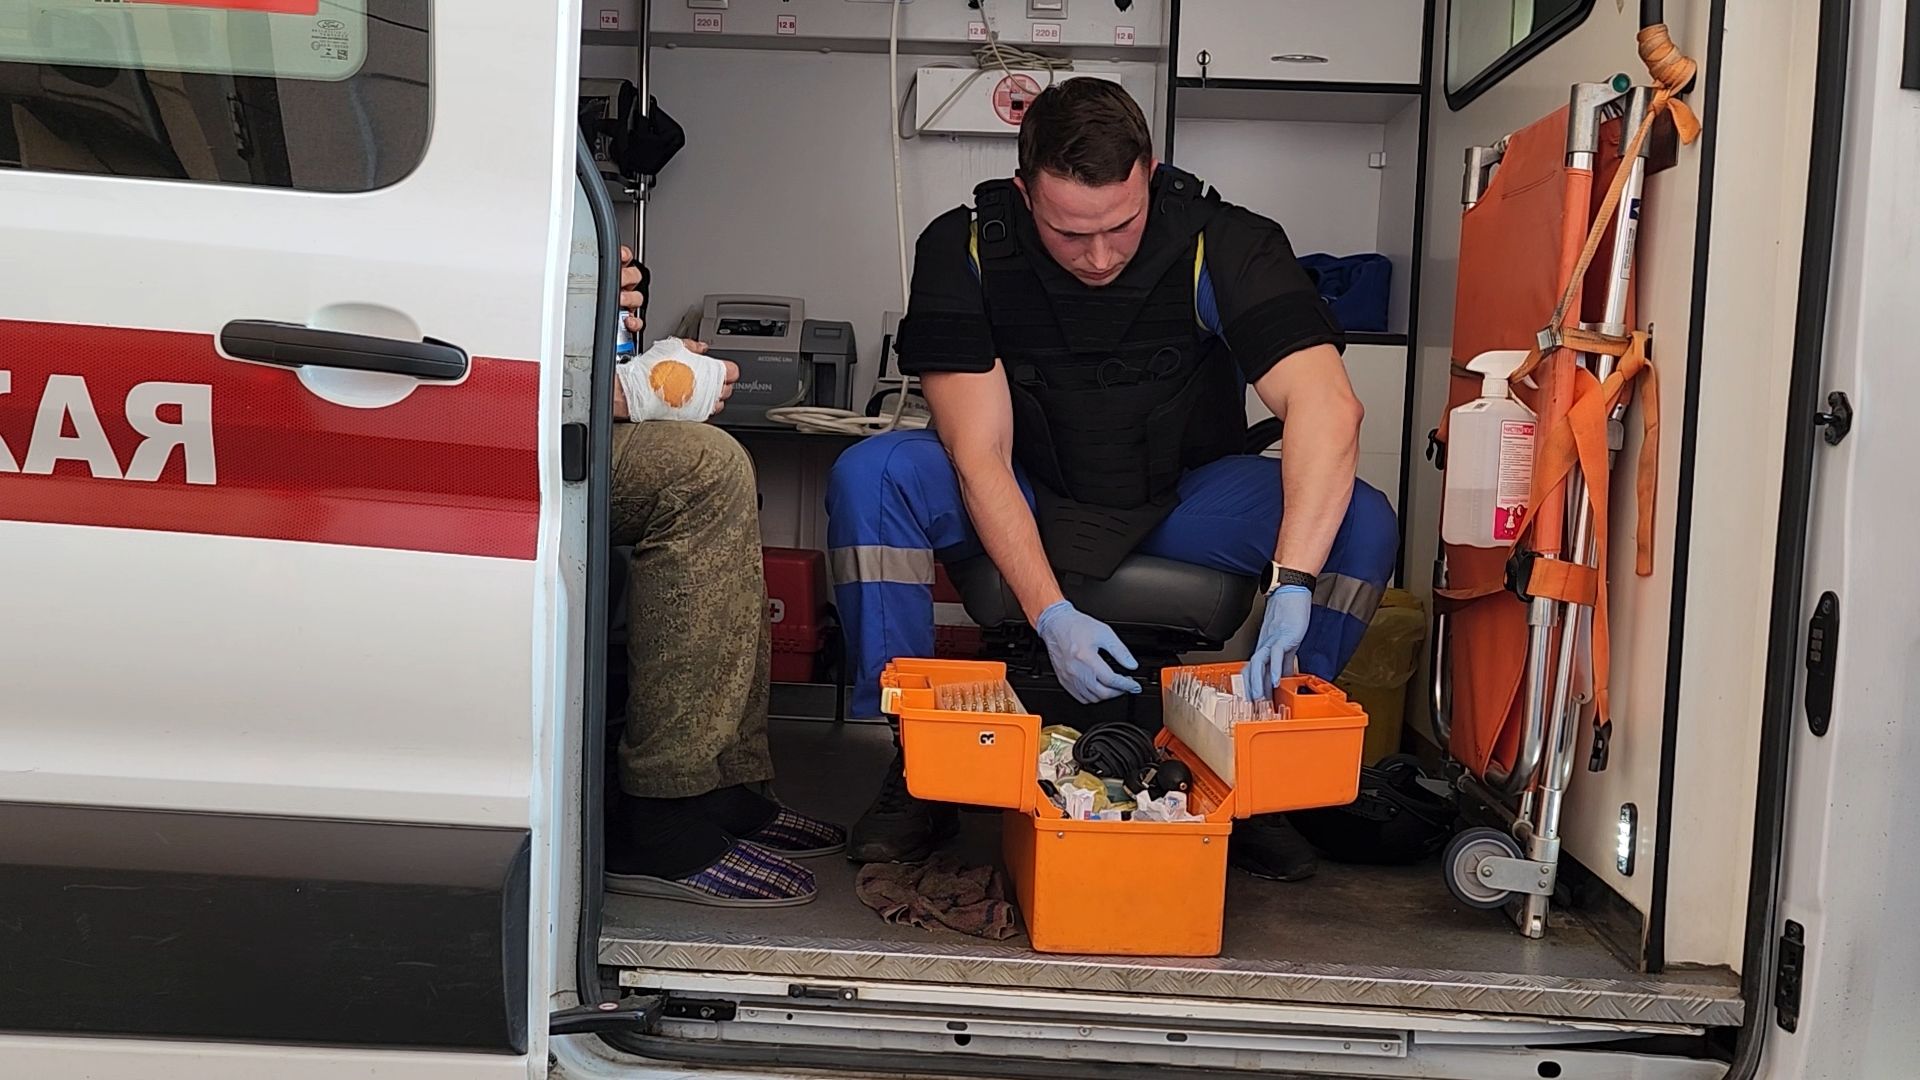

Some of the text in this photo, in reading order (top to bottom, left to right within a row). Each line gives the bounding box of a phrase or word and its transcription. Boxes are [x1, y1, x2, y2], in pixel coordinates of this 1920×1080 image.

[601, 16, 611, 24] 12
[697, 18, 712, 27] 220
[779, 21, 788, 29] 12
[970, 27, 980, 35] 12
[1035, 28, 1051, 37] 220
[1117, 32, 1127, 40] 12
